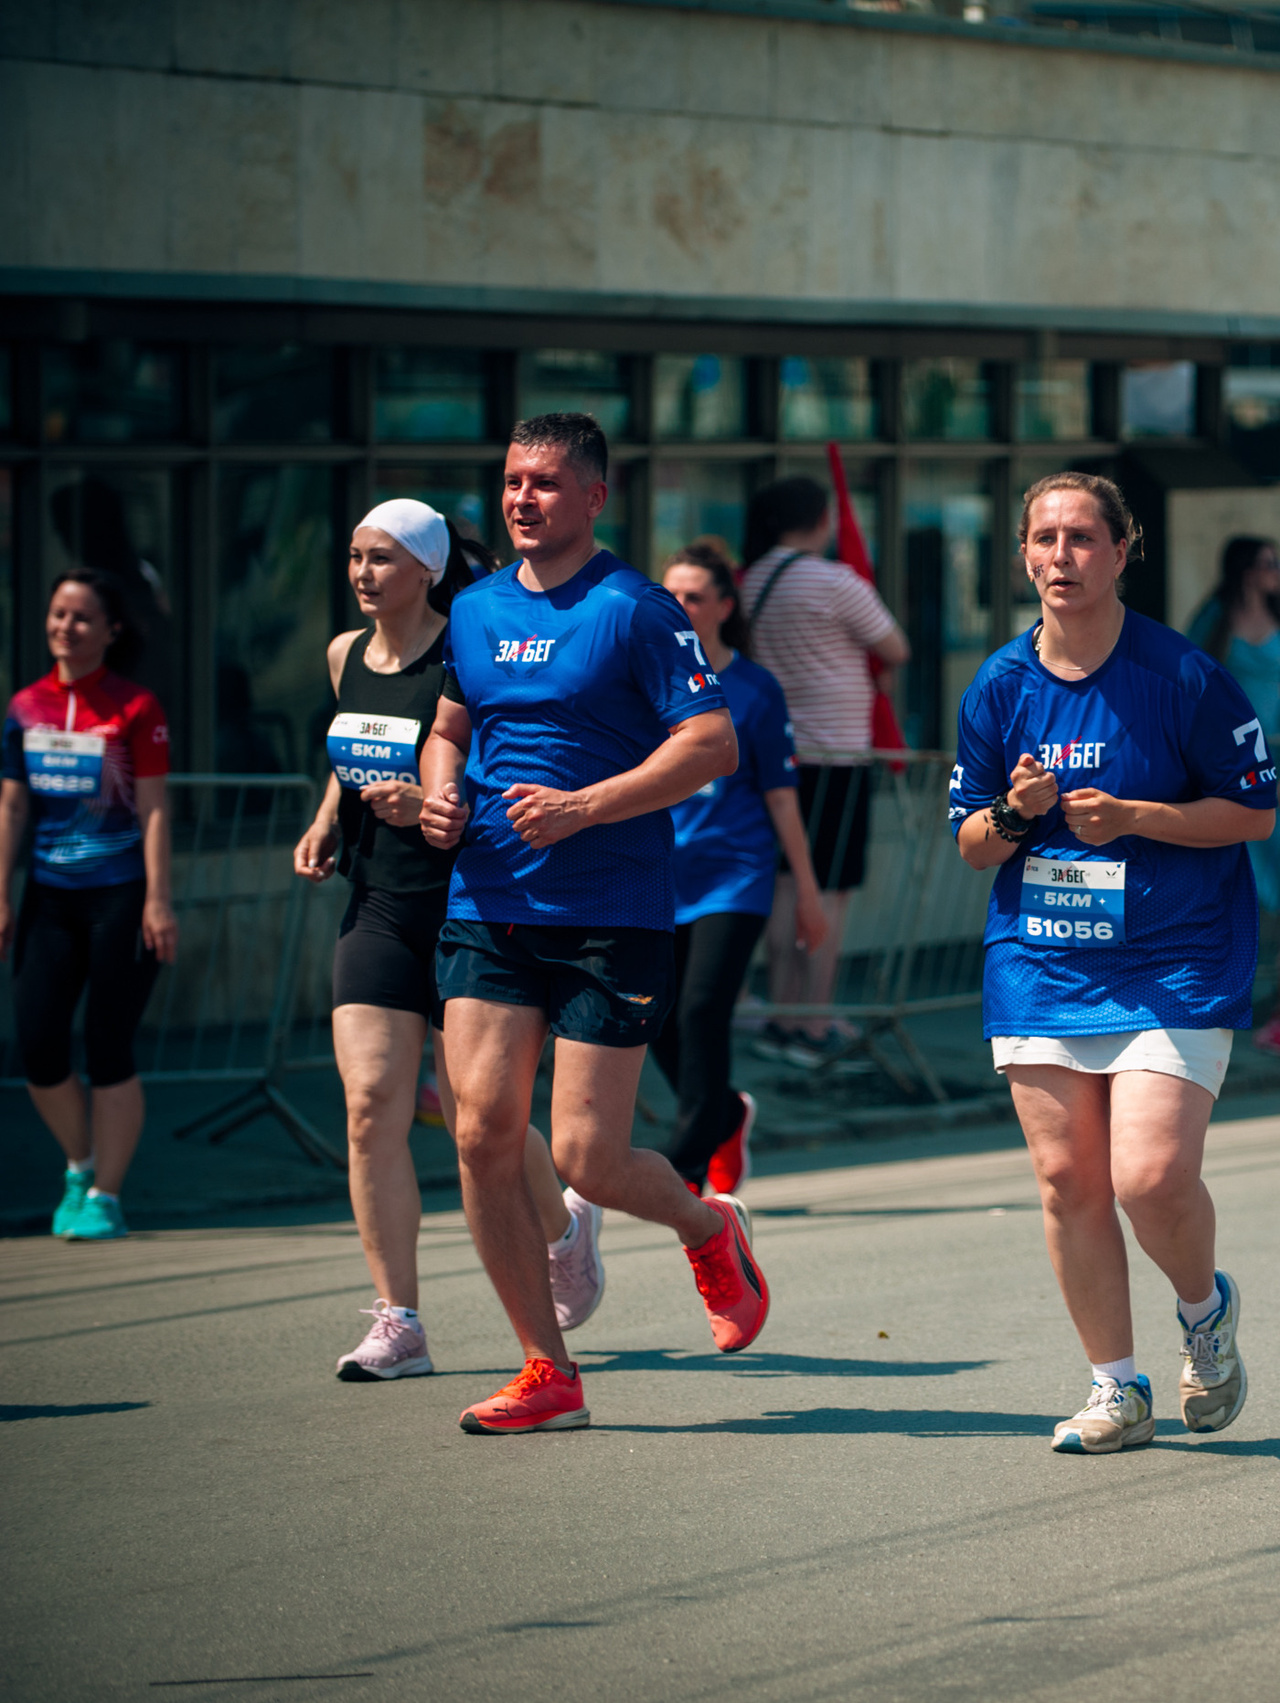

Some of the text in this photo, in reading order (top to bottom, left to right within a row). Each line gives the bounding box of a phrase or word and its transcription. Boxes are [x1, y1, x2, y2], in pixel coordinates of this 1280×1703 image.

[674, 631, 706, 666] 7
[1232, 717, 1268, 763] 7
[1027, 916, 1114, 940] 51056
